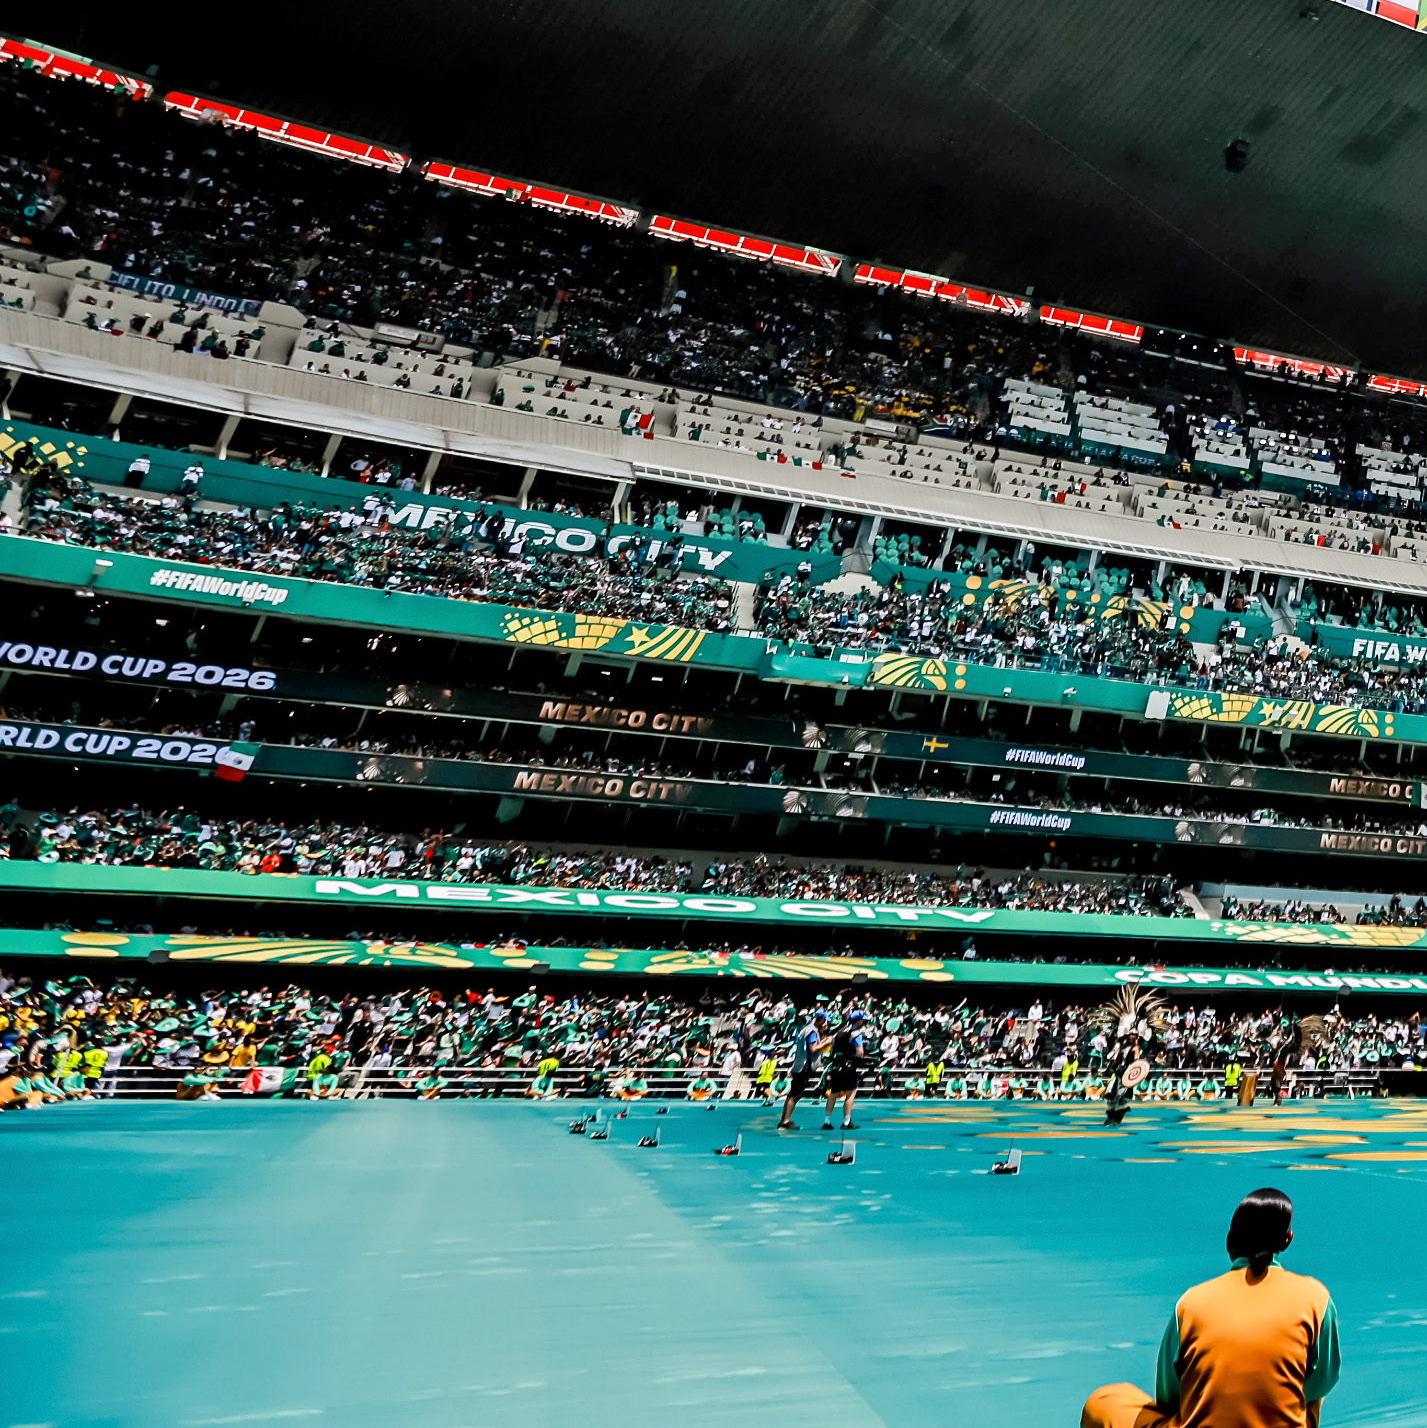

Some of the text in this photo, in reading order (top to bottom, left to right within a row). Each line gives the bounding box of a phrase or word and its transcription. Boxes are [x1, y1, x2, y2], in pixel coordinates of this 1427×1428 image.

[150, 569, 288, 605] #FIFAWorldCup
[1352, 638, 1400, 662] FIFA
[101, 654, 166, 678] CUP
[167, 662, 276, 690] 2026
[539, 701, 714, 733] MEXICO CITY
[64, 732, 131, 755] CUP
[1005, 748, 1086, 770] #FIFAWorldCup
[513, 771, 693, 801] MEXICO CITY
[990, 811, 1071, 831] #FIFAWorldCup
[314, 878, 995, 923] MEXICO CITY
[1115, 969, 1263, 985] COPA
